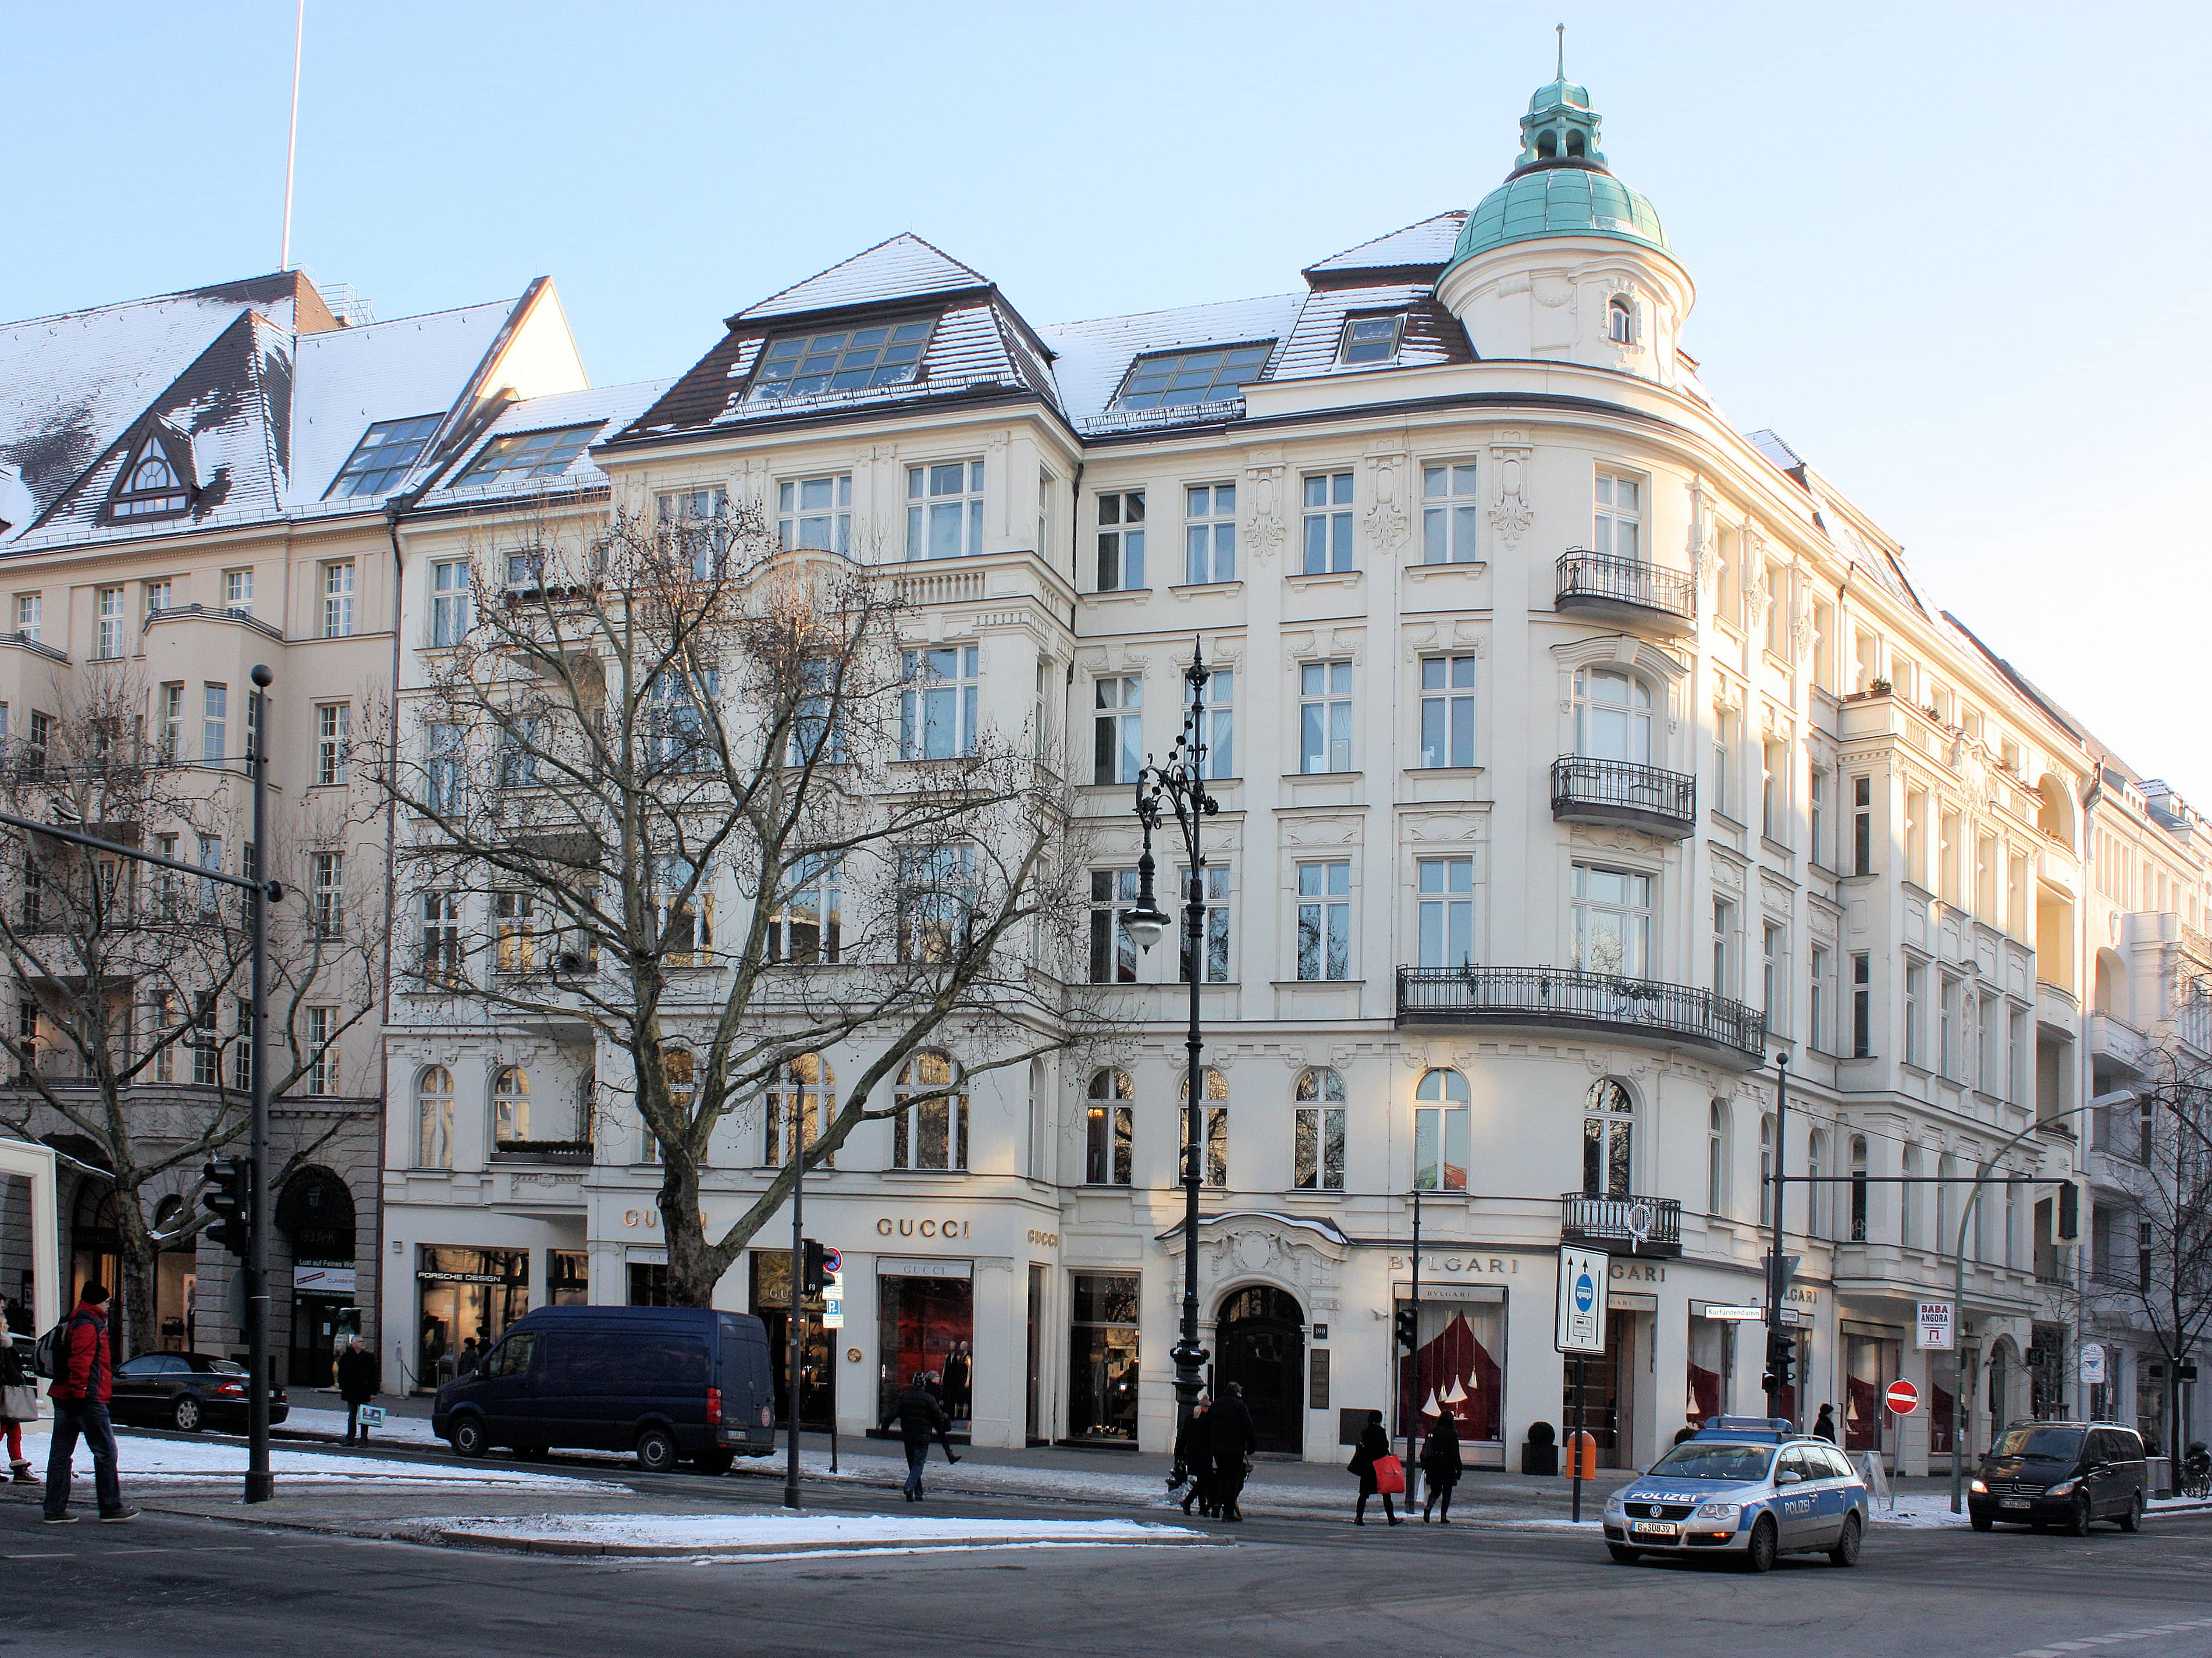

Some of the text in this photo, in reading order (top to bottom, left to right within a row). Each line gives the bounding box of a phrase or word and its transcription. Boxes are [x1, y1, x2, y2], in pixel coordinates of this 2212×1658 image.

[623, 1209, 707, 1229] GUI
[877, 1218, 969, 1238] GUCCI
[1027, 1230, 1058, 1248] GUCCI
[904, 1265, 945, 1275] GUCCI
[1610, 1265, 1666, 1282] GARI
[418, 1272, 500, 1282] PORSCHE DESIGN
[1784, 1288, 1818, 1304] LGARI
[1708, 1308, 1759, 1317] Kurfürstendamm
[1921, 1305, 1948, 1313] BABA
[1921, 1314, 1948, 1322] ANGORA
[1630, 1492, 1697, 1503] POLIZEI
[1784, 1499, 1811, 1514] POLIZEI
